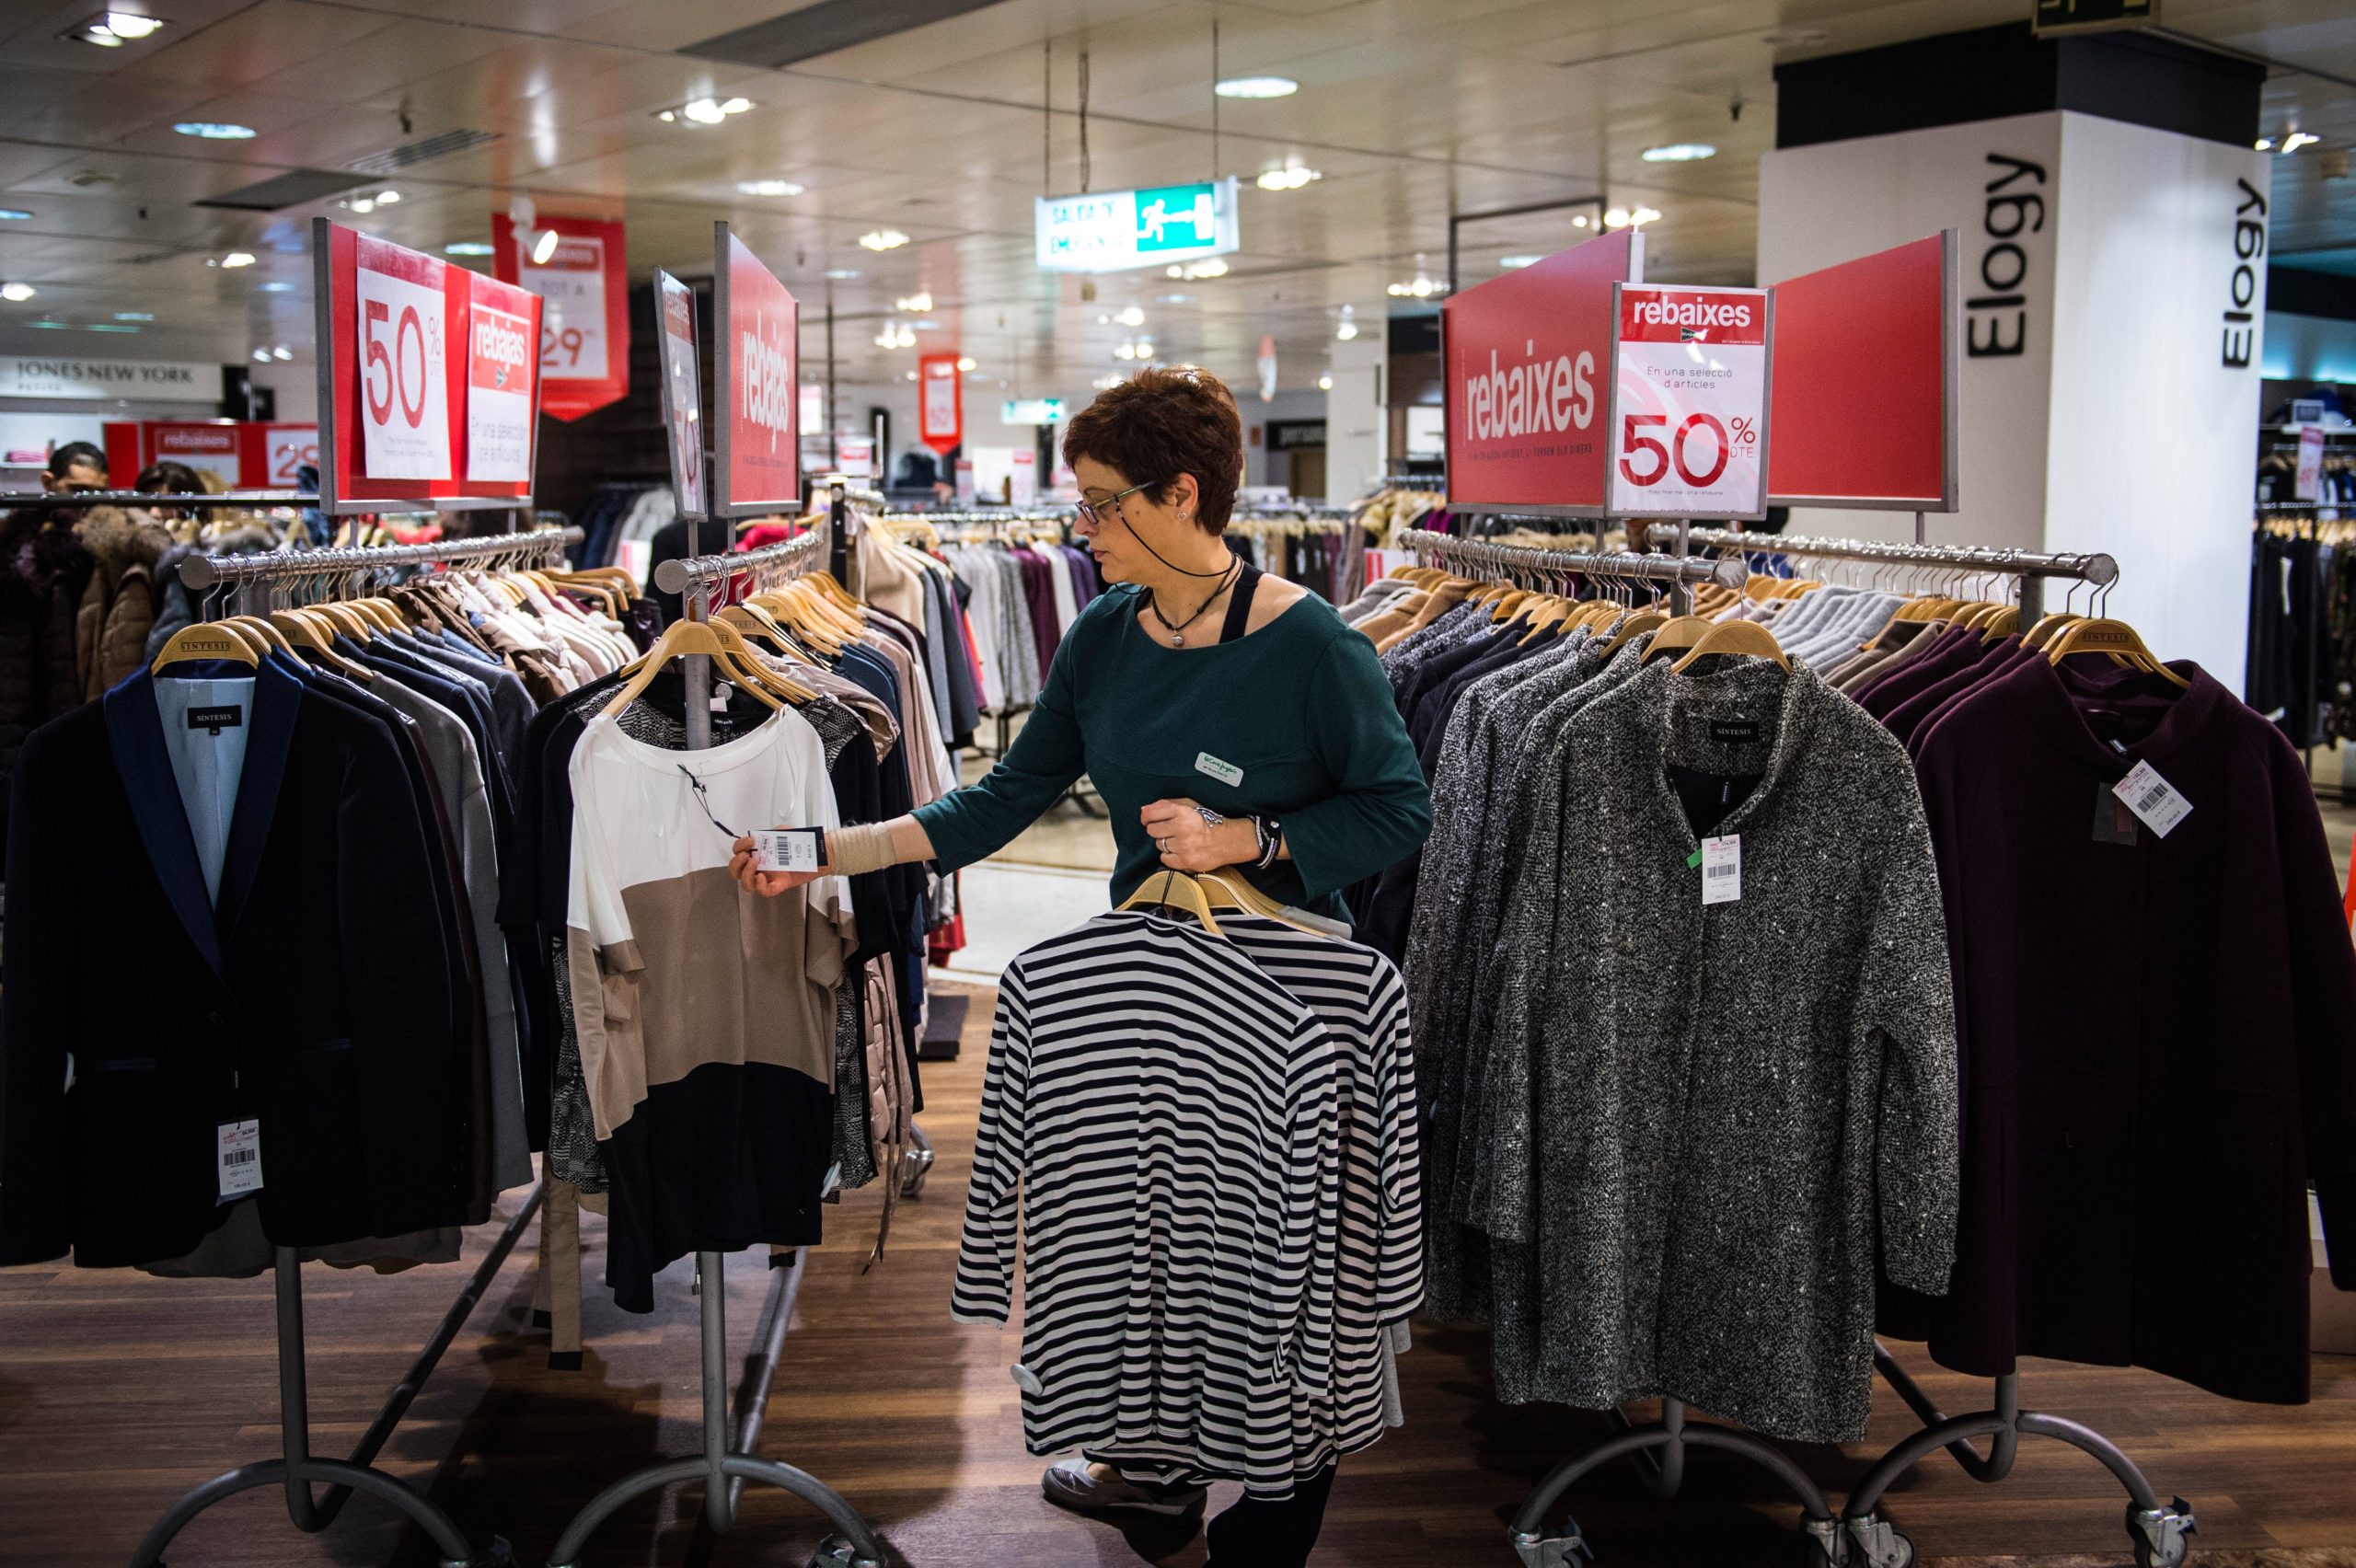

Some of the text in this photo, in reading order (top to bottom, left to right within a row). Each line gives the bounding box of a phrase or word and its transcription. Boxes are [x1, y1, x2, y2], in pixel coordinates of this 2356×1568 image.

[1967, 154, 2046, 358] Elogy
[2222, 177, 2266, 369] Elogy
[476, 314, 525, 373] rebajas
[1634, 295, 1750, 327] rebaixes
[17, 360, 192, 384] JONES NEW YORK
[365, 299, 426, 429] 50
[743, 308, 789, 455] rebajas
[1467, 339, 1595, 441] rebaixes
[1647, 366, 1733, 377] En una selecció
[1619, 412, 1729, 488] 50
[1729, 446, 1754, 458] DTE
[1731, 417, 1756, 444] %
